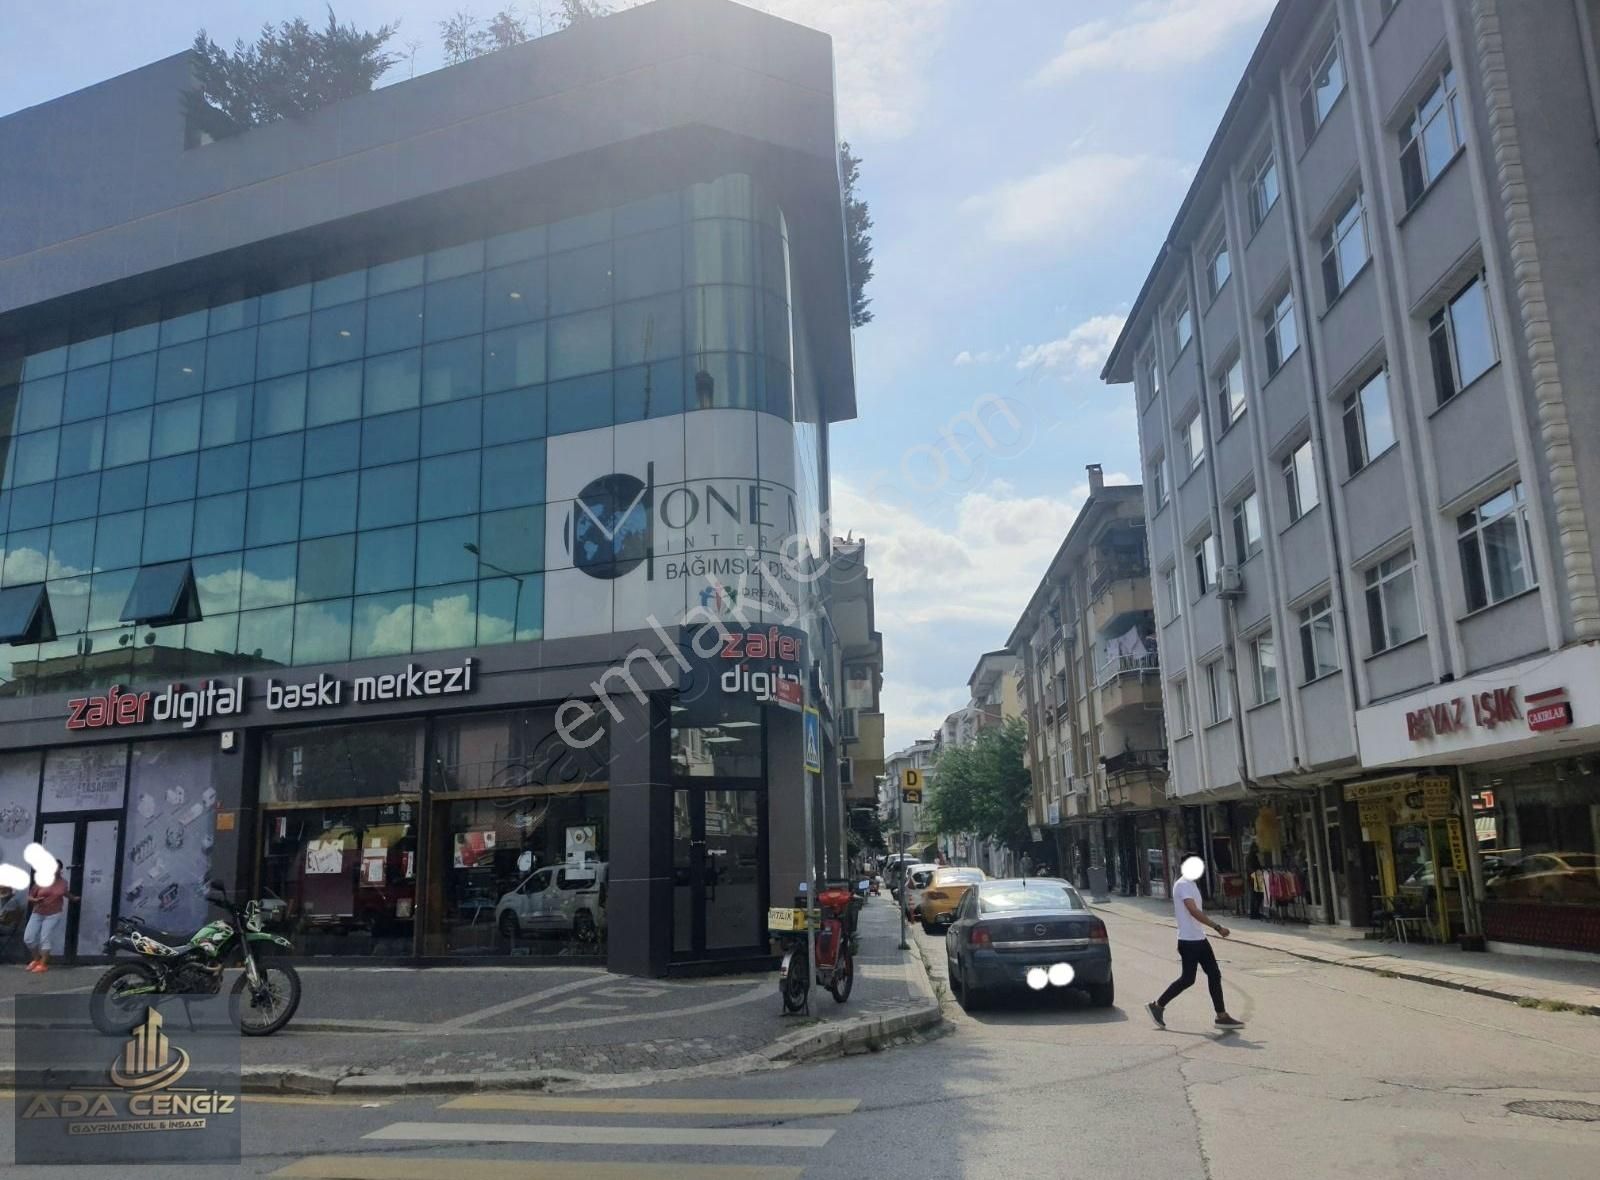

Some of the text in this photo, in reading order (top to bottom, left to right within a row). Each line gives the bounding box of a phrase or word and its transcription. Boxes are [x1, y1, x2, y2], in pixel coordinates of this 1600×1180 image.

[665, 555, 760, 580] BAĞIMSIZ
[65, 657, 473, 730] zafer digital baskı merkezi
[1406, 685, 1524, 741] BEYAZ IŞIK
[906, 770, 918, 786] D
